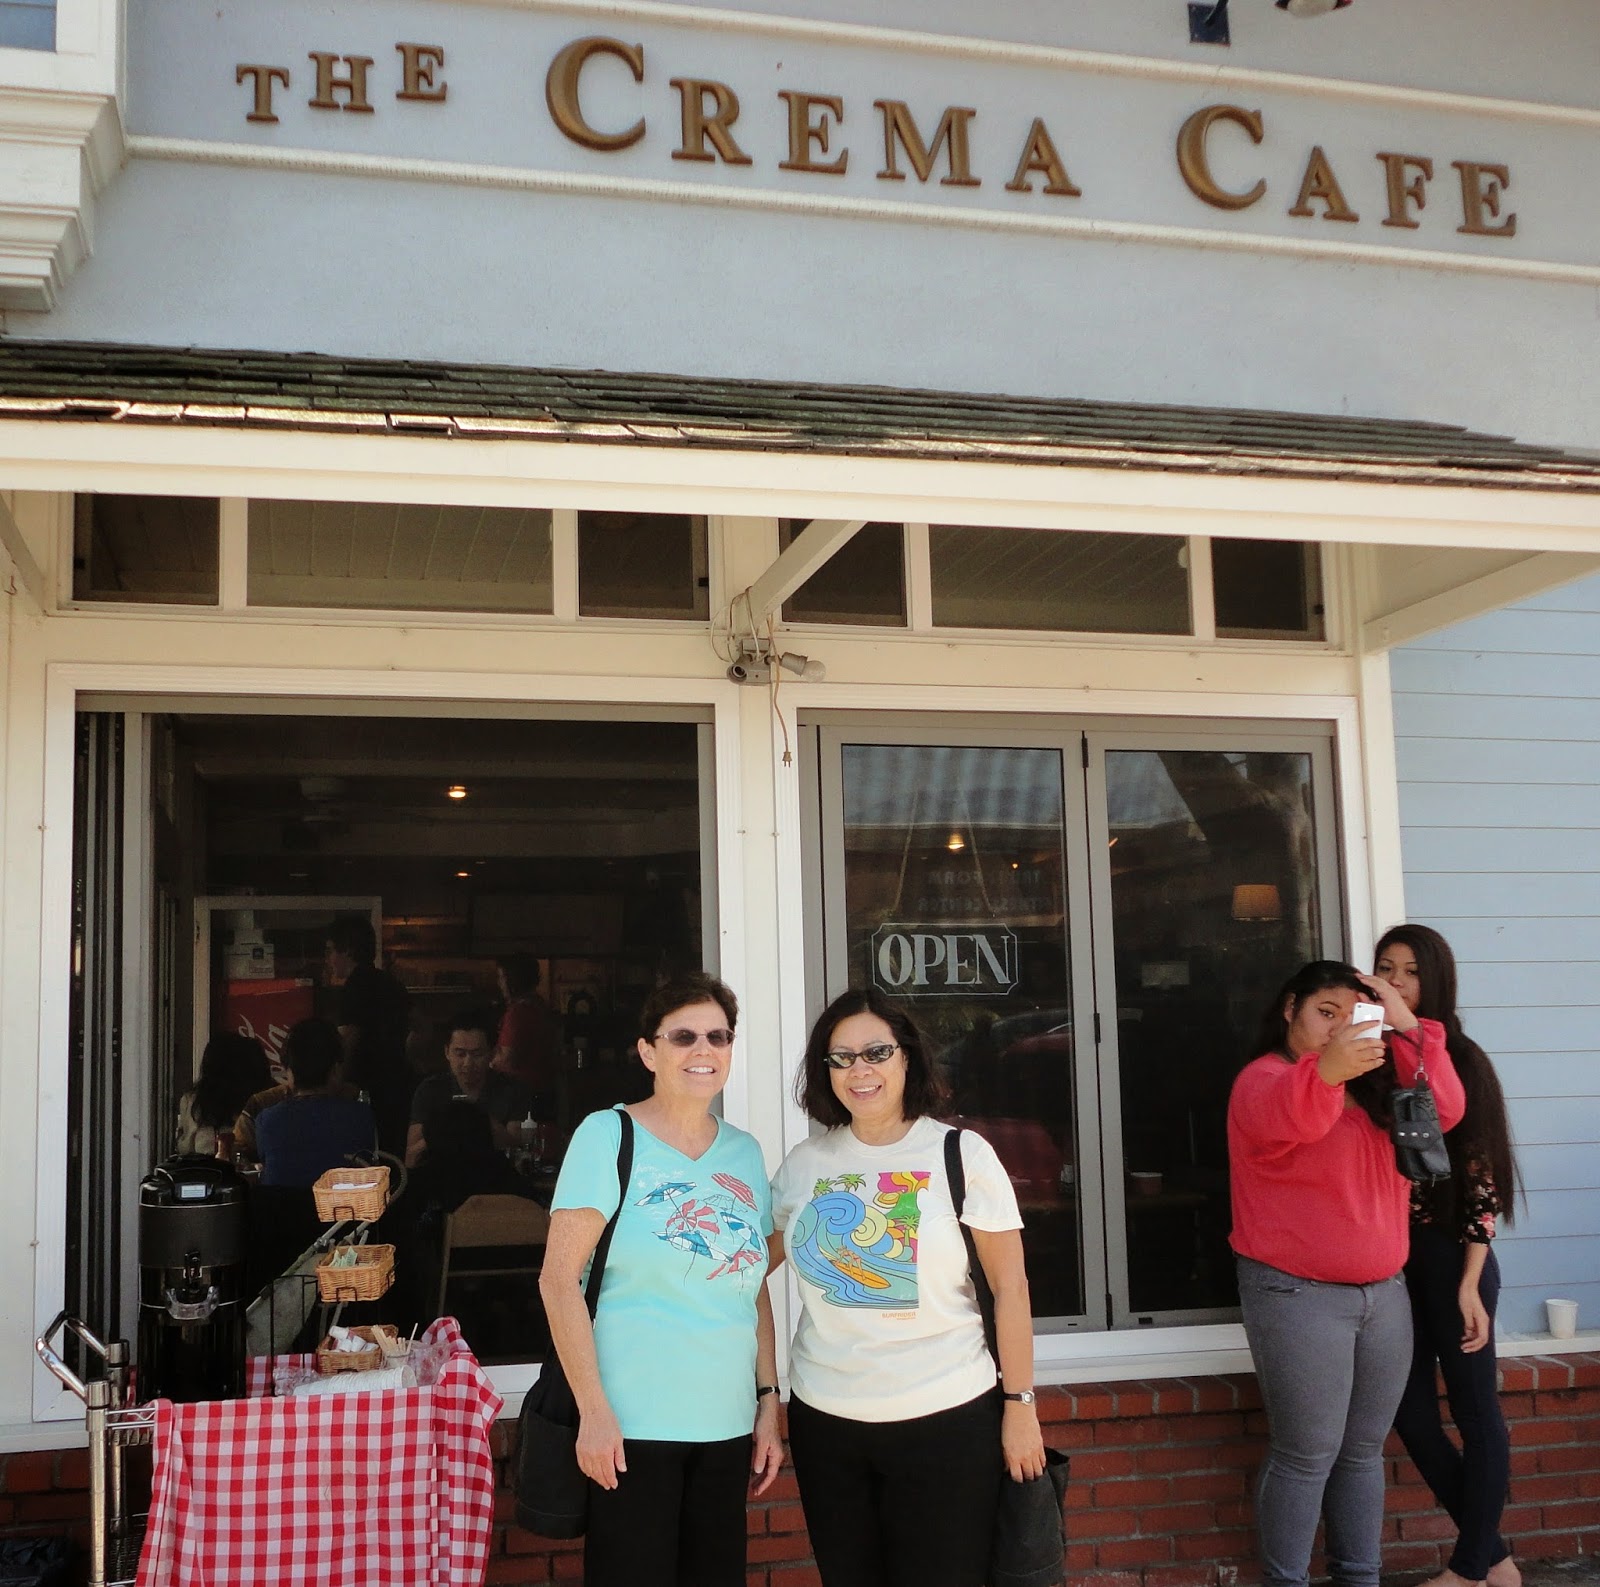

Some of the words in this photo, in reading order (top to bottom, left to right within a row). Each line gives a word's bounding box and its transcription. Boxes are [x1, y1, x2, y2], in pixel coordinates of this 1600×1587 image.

[236, 41, 448, 123] THE
[545, 36, 1082, 197] CREMA
[1176, 104, 1517, 238] CAFE
[878, 933, 1011, 985] OPEN
